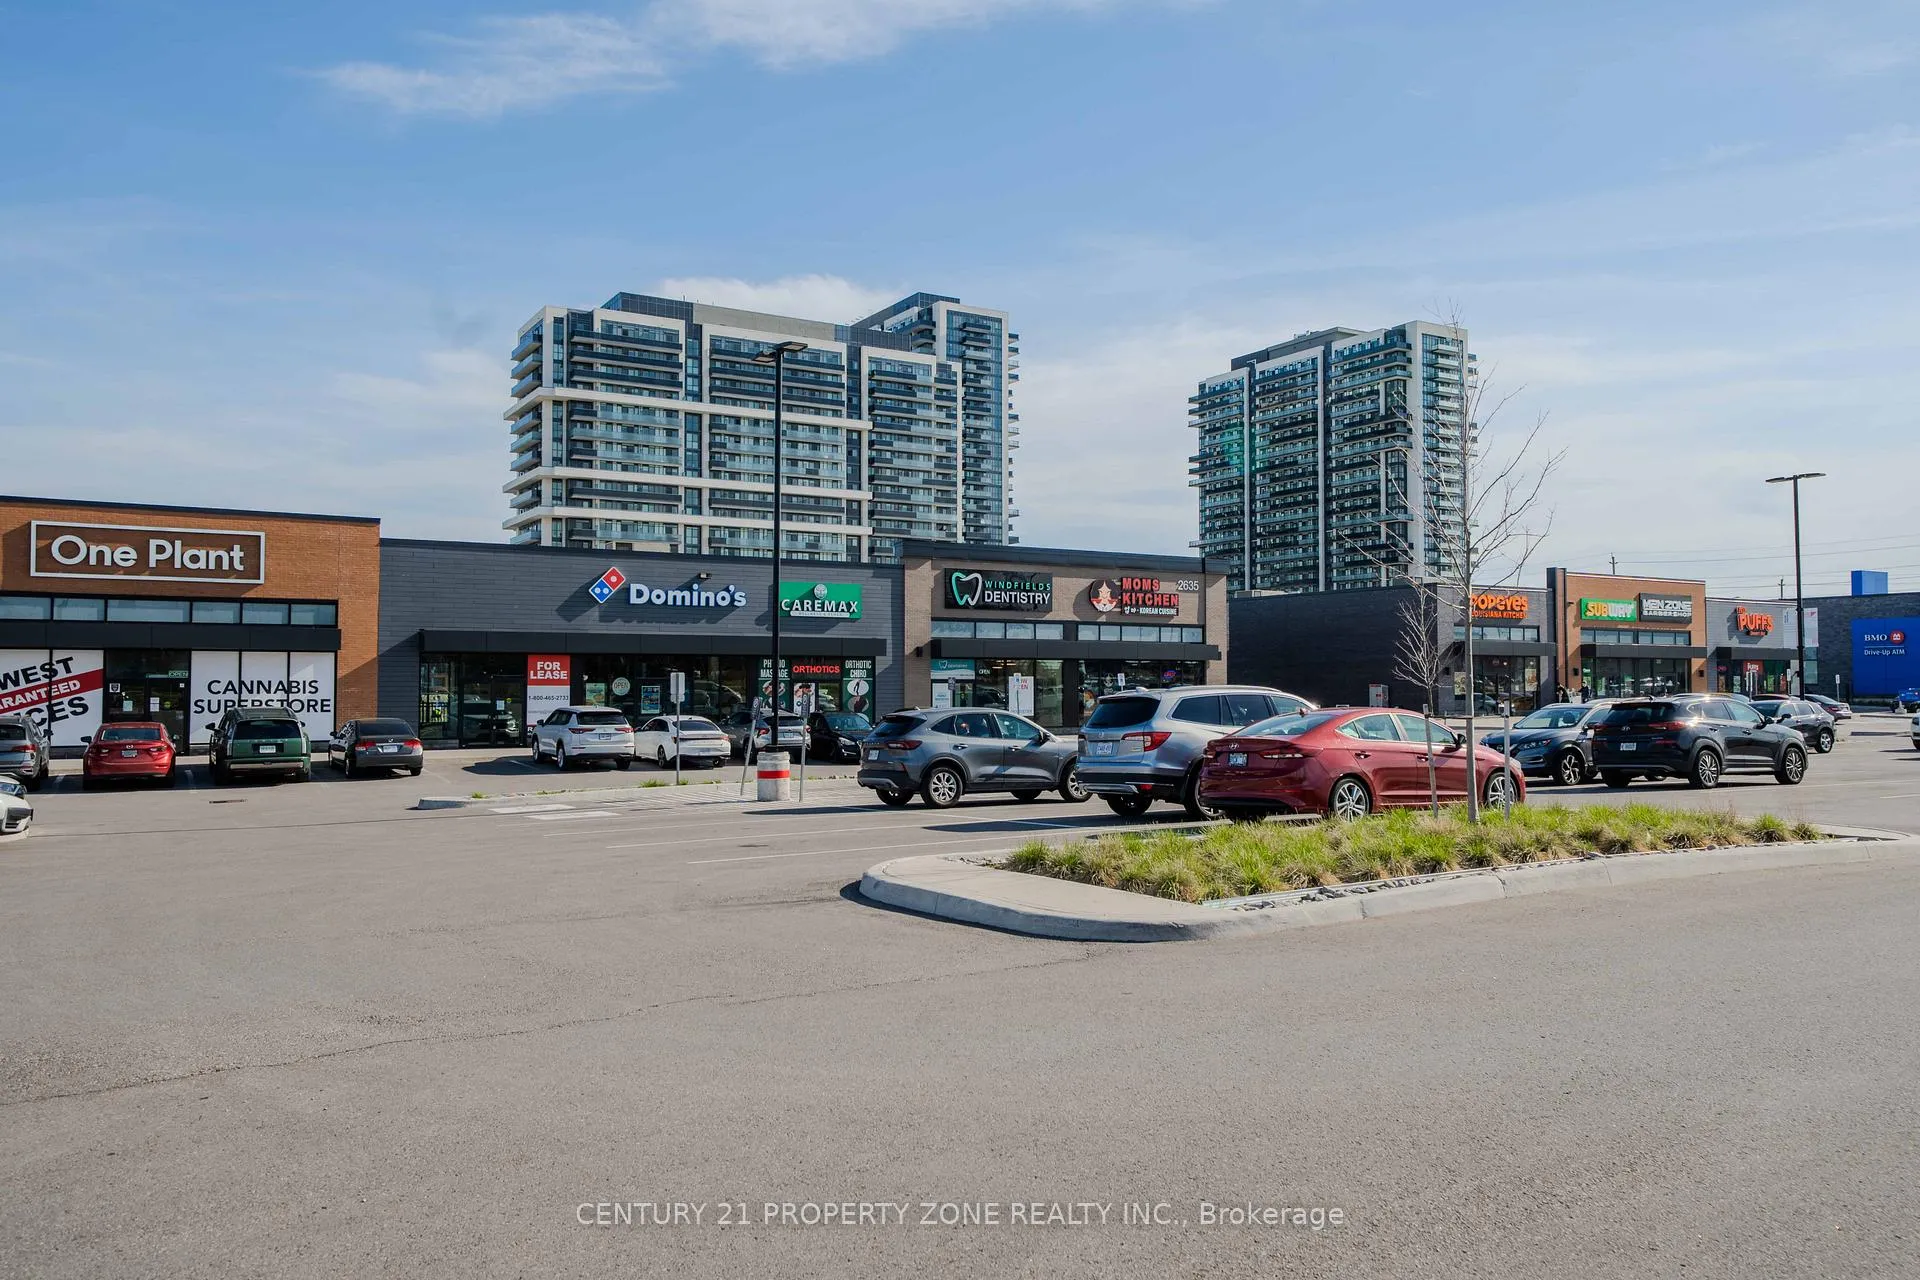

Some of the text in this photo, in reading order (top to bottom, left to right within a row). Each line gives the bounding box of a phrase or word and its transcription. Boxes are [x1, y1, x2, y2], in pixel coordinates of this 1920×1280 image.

[51, 534, 245, 571] One Plant
[984, 580, 1051, 591] WINDFIELDS
[1122, 577, 1160, 591] MOMS
[1177, 579, 1199, 591] 2635
[629, 583, 747, 607] Domino's
[984, 590, 1051, 604] DENTISTRY
[1122, 592, 1179, 607] KITCHEN
[781, 598, 858, 613] CAREMAX
[1586, 602, 1634, 618] SUBWAY
[1737, 613, 1775, 632] PUFFS
[1864, 634, 1888, 642] BMO
[536, 661, 561, 671] FOR
[763, 659, 786, 668] PHIO
[792, 665, 841, 674] ORTHOTICS
[845, 660, 872, 669] ORTHOTIC
[0, 656, 74, 691] WEST
[530, 670, 568, 680] LEASE
[760, 669, 789, 678] MASGE
[849, 669, 867, 678] CHIRO
[207, 679, 319, 695] CANNABIS
[14, 696, 89, 727] CES
